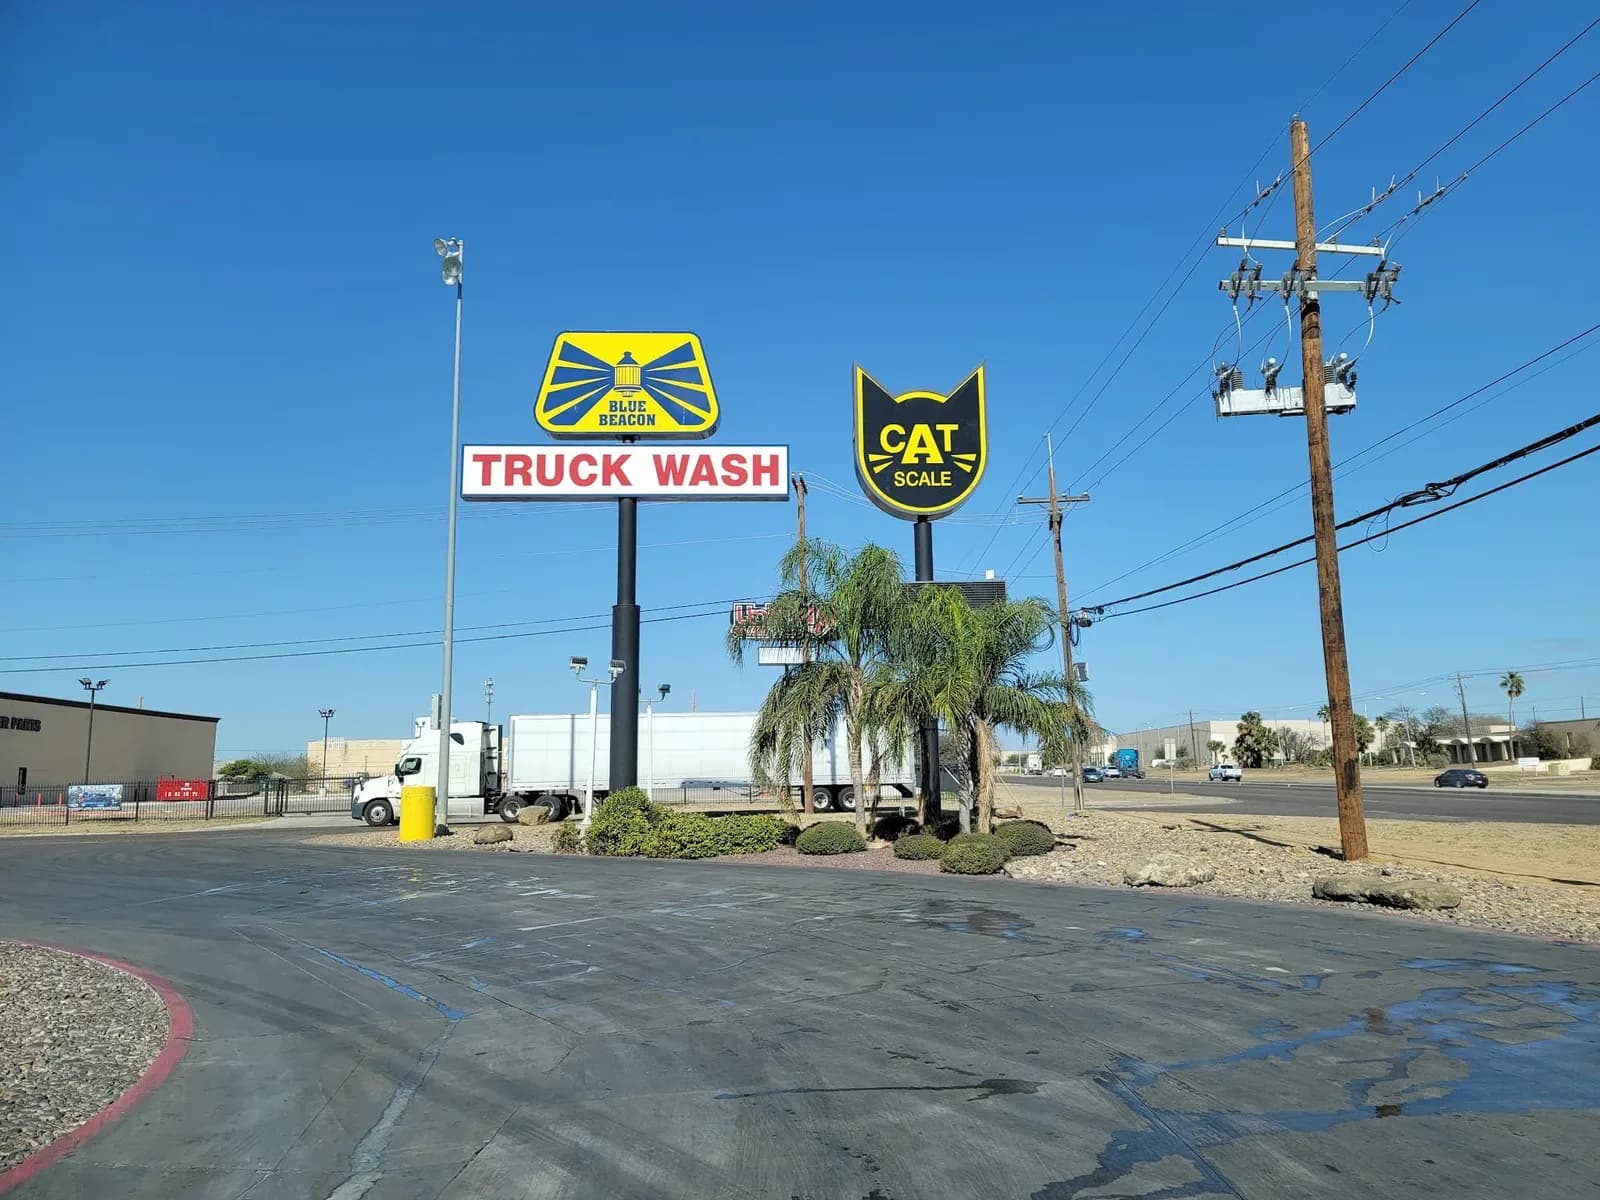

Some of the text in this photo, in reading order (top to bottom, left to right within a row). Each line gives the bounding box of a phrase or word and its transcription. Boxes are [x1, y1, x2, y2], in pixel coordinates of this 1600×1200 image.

[609, 400, 647, 413] BLUE
[598, 414, 656, 426] BEACON
[880, 423, 960, 465] CAT
[473, 453, 780, 487] TRUCK WASH
[894, 471, 953, 487] SCALE
[10, 716, 42, 732] PARTS
